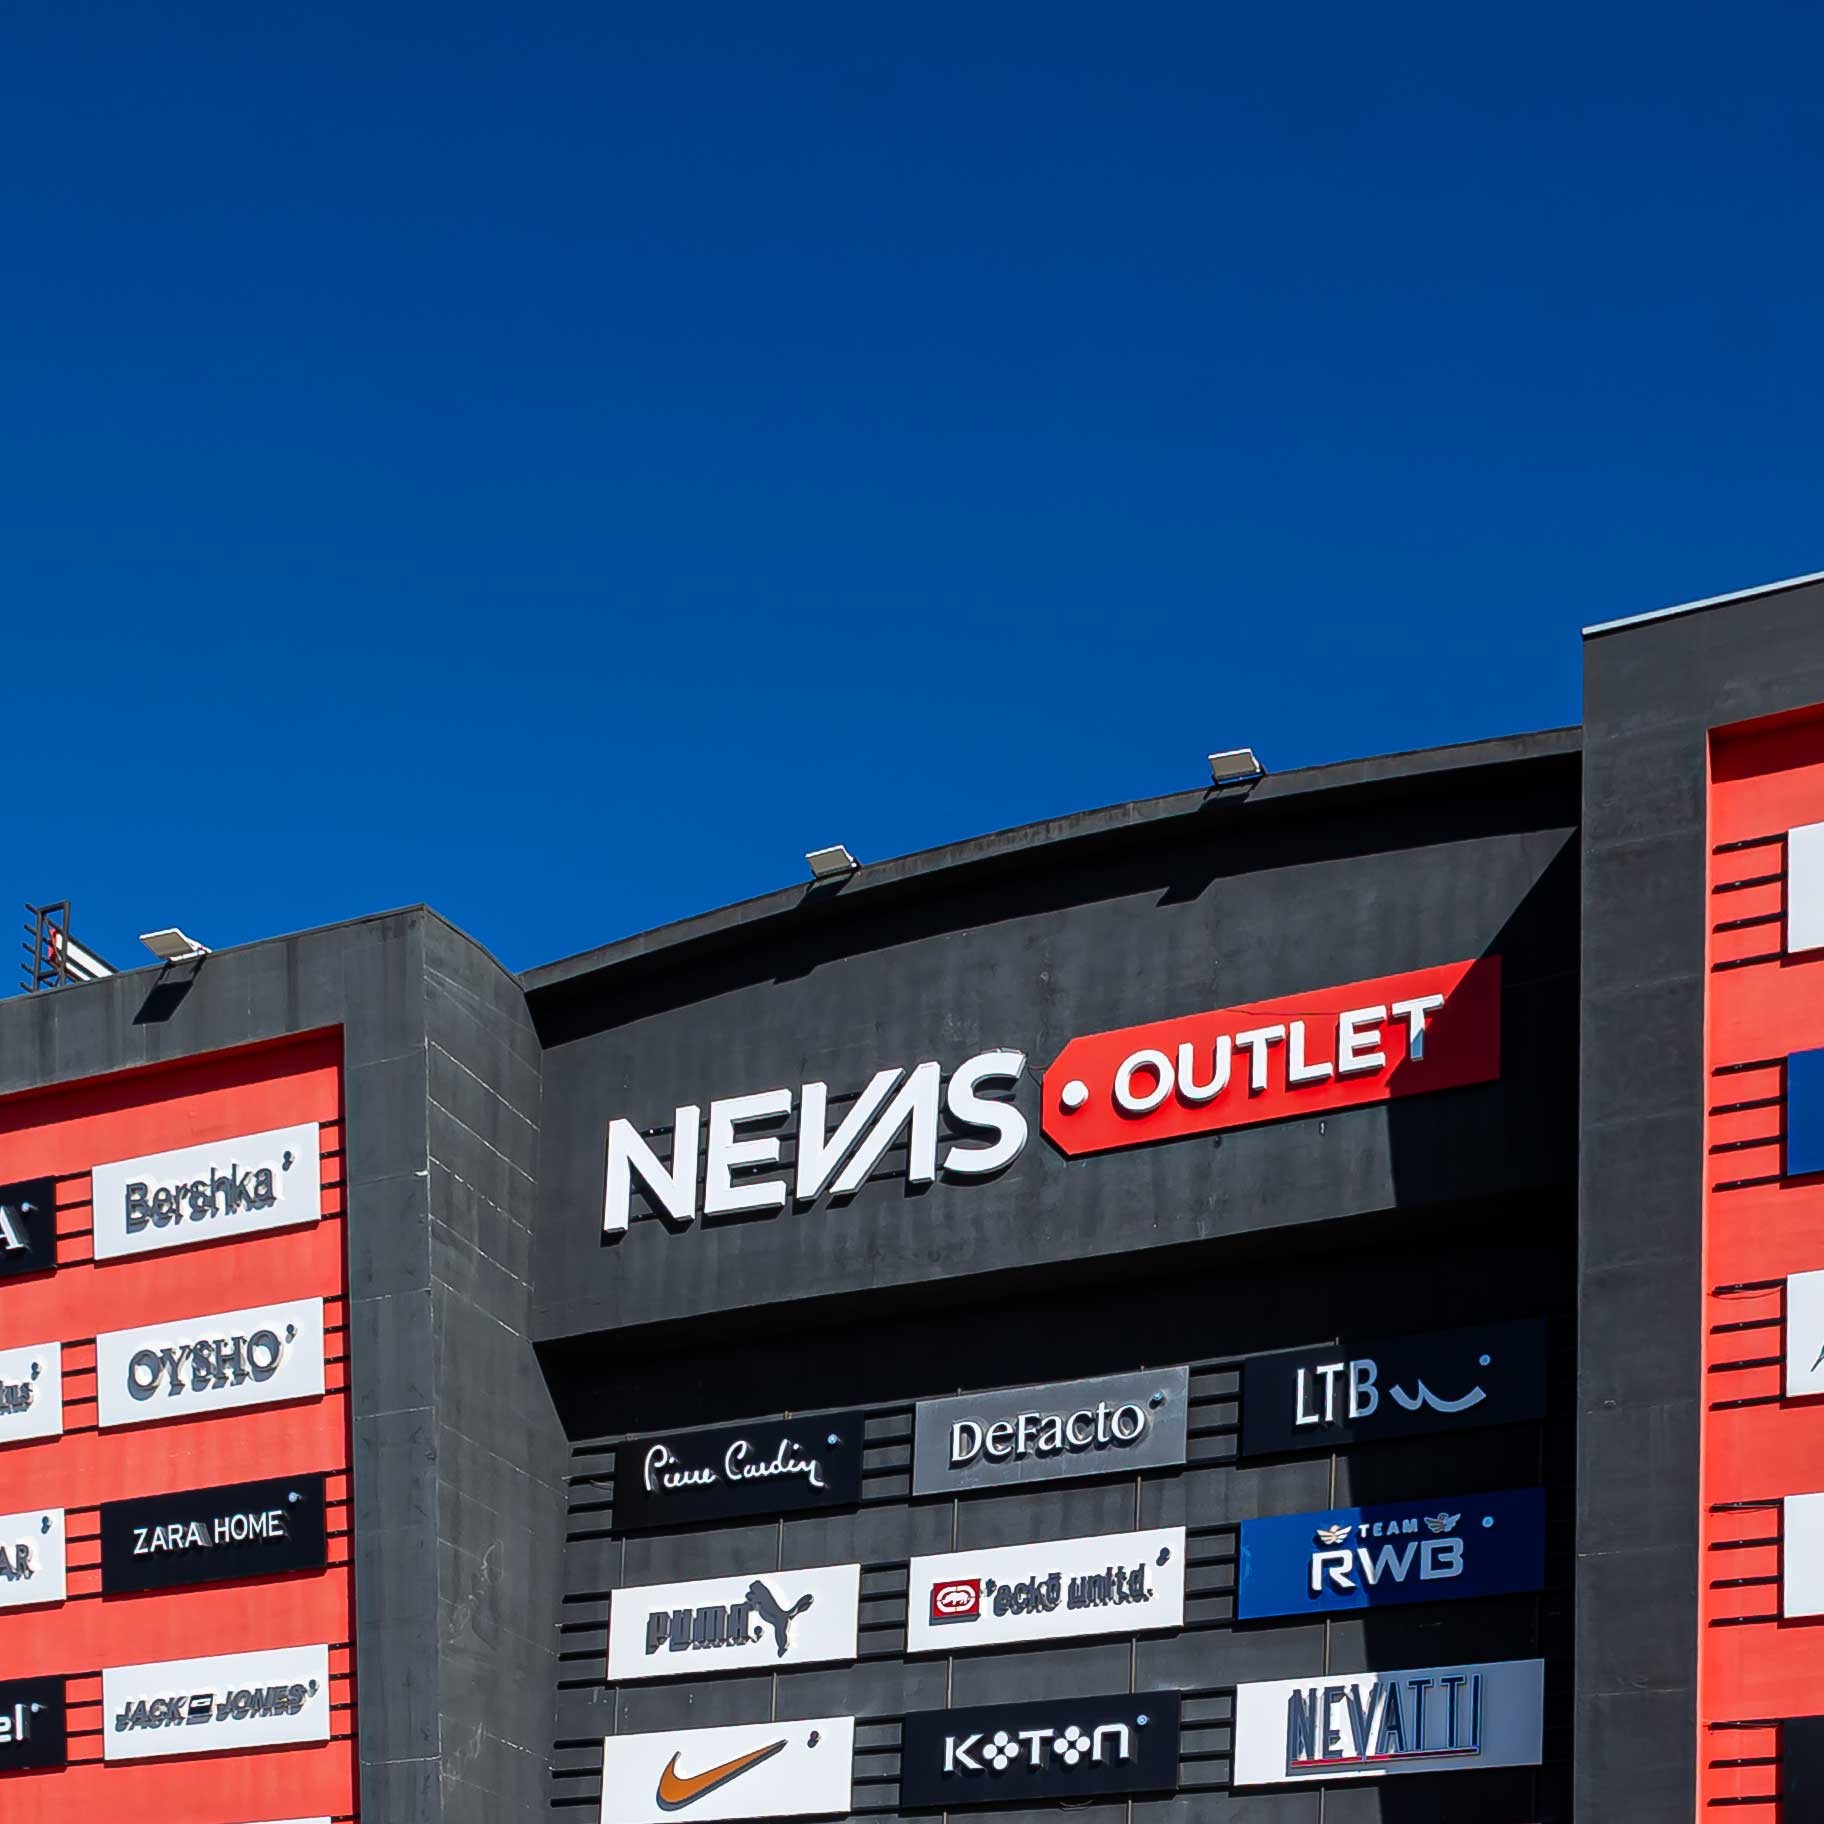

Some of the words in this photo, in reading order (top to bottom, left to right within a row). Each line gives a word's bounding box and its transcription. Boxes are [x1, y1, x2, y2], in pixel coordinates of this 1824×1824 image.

[603, 1048, 1027, 1234] NEVAS
[1113, 994, 1445, 1115] OUTLET
[125, 1163, 277, 1232] Bershka
[127, 1329, 282, 1400] OYSHO
[1295, 1359, 1379, 1426] LTB
[950, 1402, 1146, 1465] DeFacto
[133, 1526, 204, 1556] ZARA
[213, 1509, 285, 1541] HOME
[1358, 1518, 1419, 1538] TEAM
[1311, 1537, 1465, 1592] RWB
[646, 1602, 753, 1655] PUMA
[114, 1697, 186, 1733] JACK
[216, 1684, 307, 1724] JONES
[1287, 1672, 1482, 1764] NEVATTI
